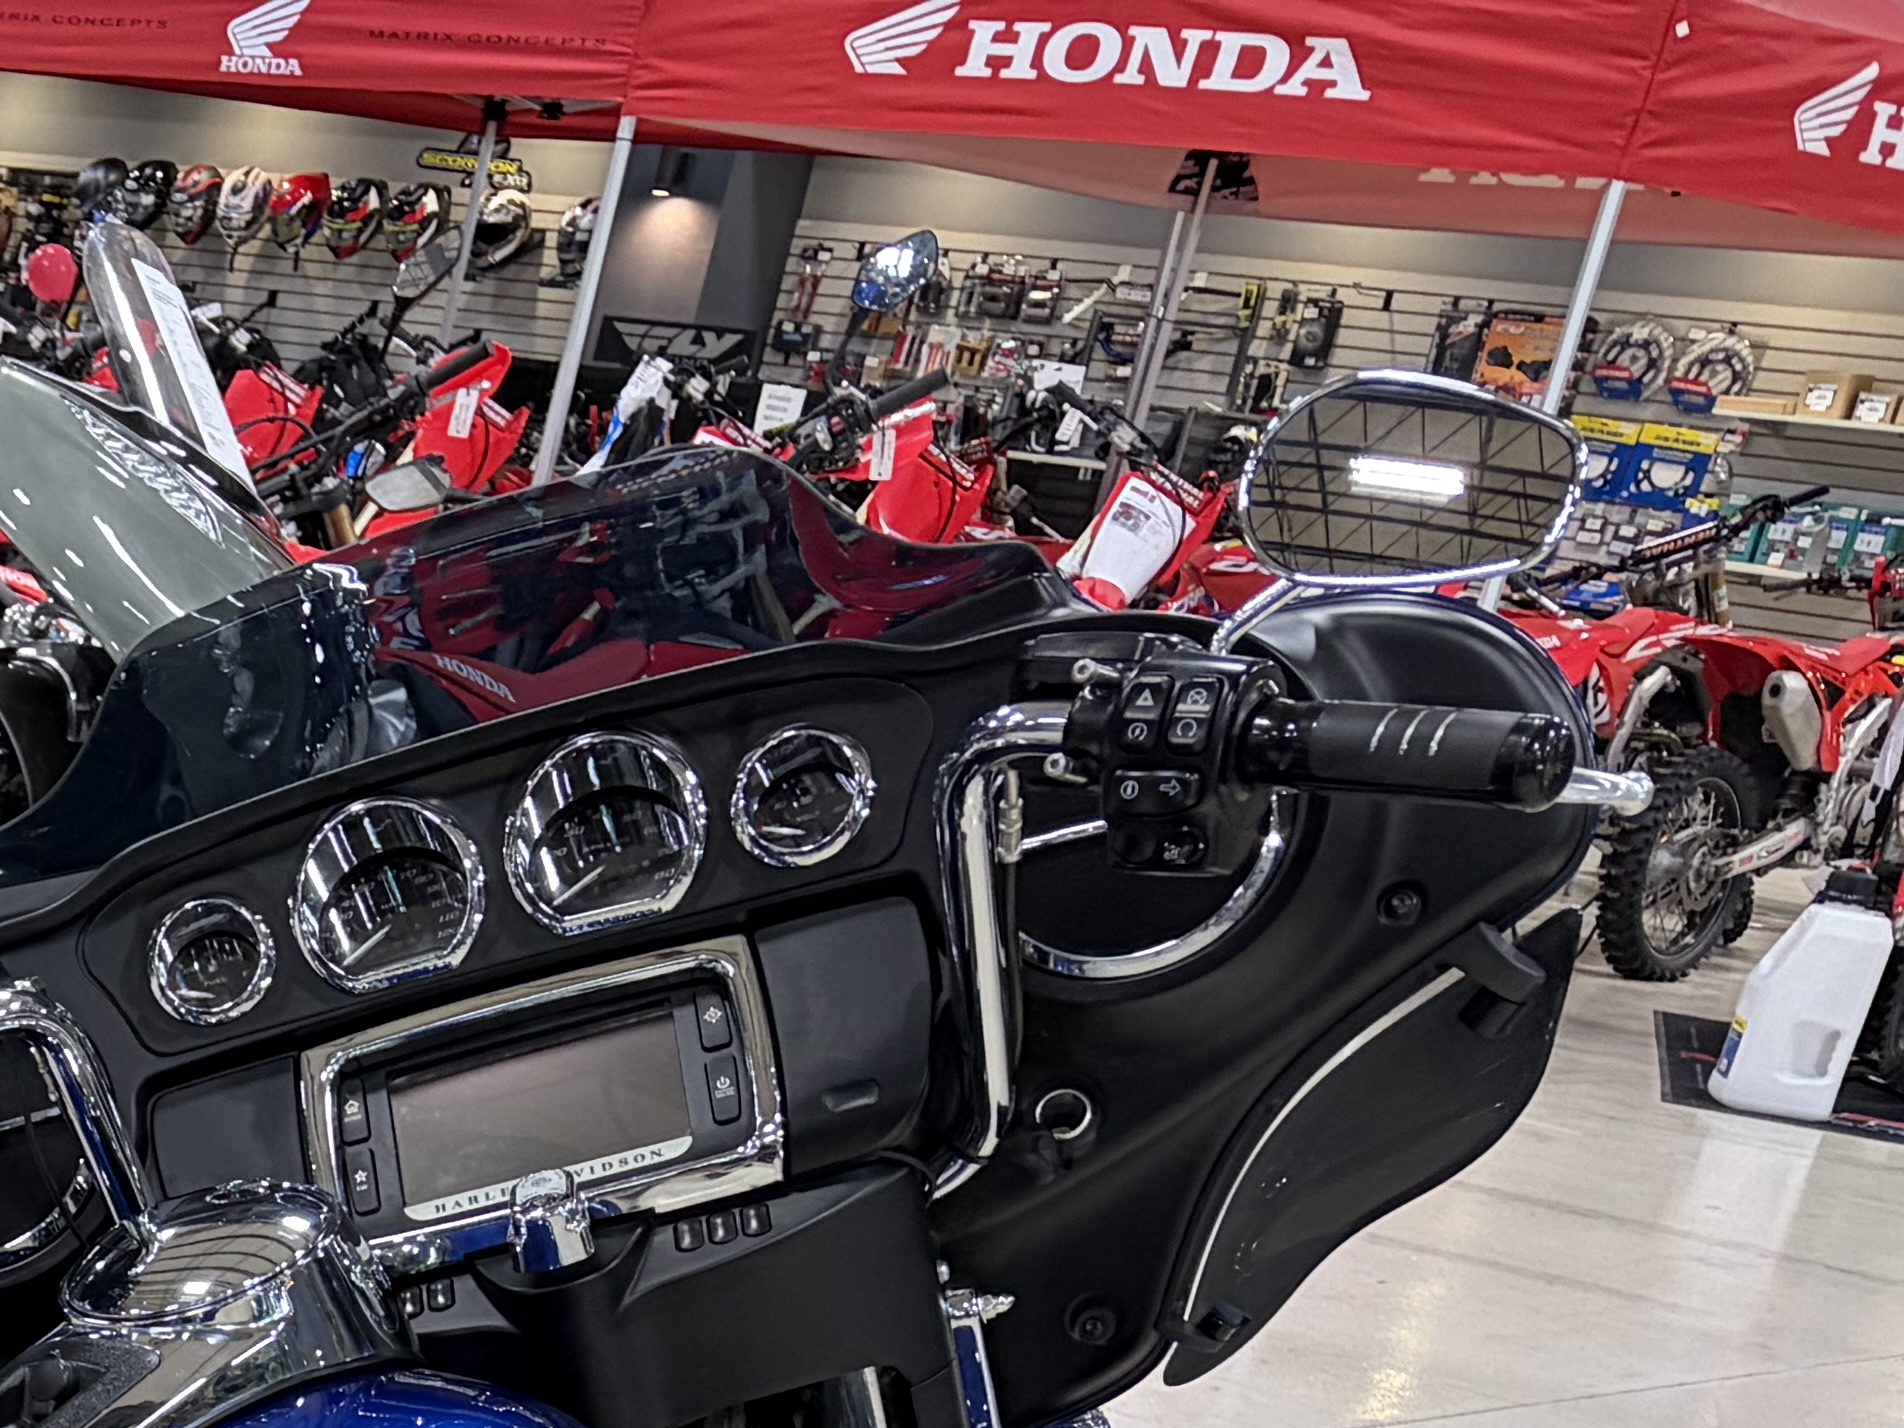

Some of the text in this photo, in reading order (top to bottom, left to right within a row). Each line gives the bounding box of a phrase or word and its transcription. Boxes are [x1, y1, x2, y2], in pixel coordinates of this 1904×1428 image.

[51, 14, 168, 29] CONCEPTS
[369, 29, 608, 48] MATRIX CONCEPTS
[219, 53, 303, 76] HONDA
[954, 20, 1371, 101] HONDA
[421, 152, 519, 174] SCORPON
[613, 321, 746, 359] FLY
[432, 653, 517, 704] HONDA
